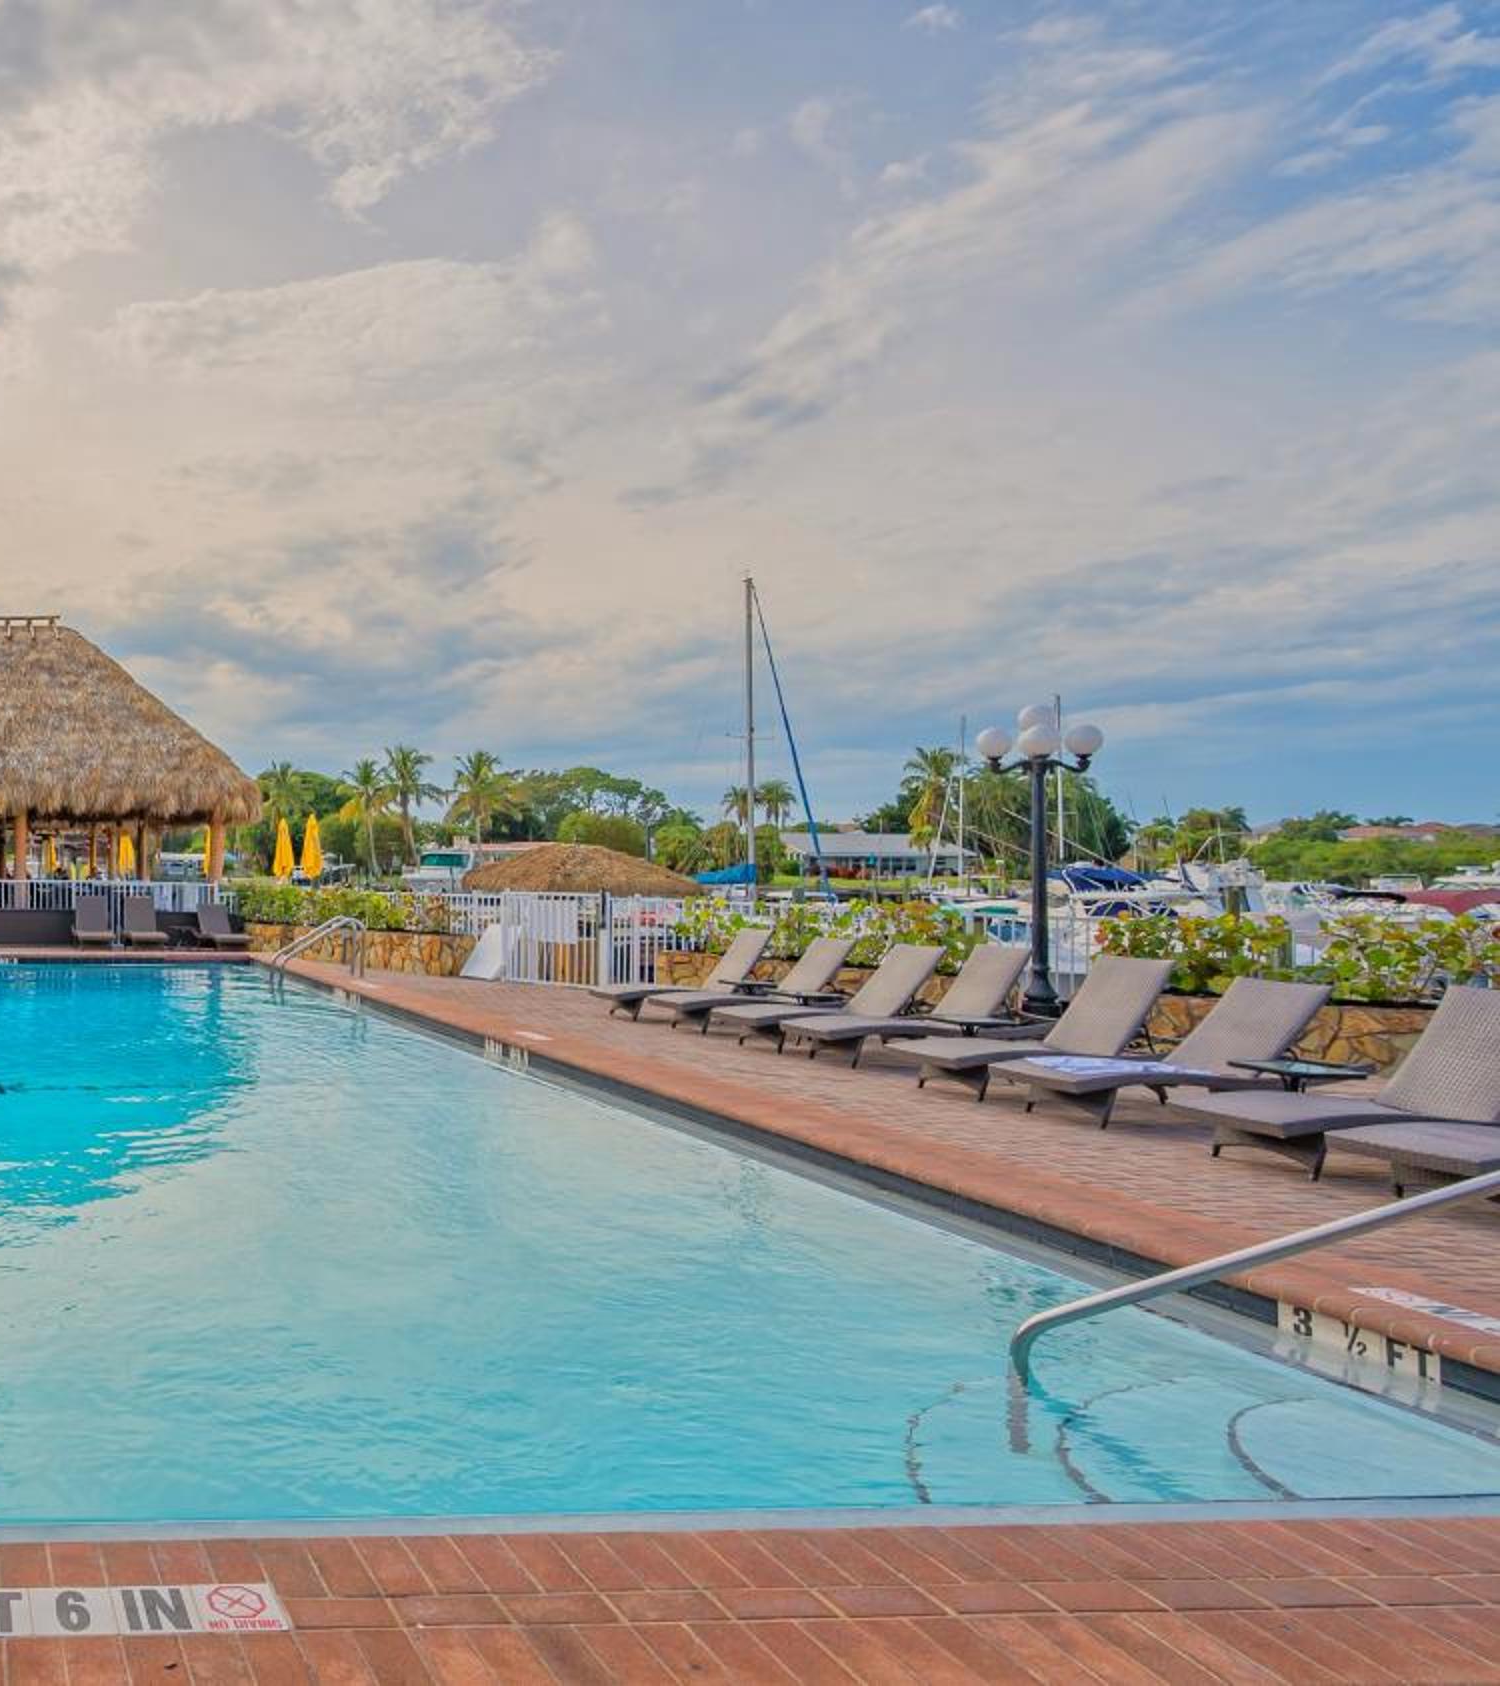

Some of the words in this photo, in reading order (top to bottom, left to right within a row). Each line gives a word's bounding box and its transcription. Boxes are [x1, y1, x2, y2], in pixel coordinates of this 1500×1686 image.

[1293, 1306, 1313, 1338] 3
[56, 1590, 92, 1632] 6
[120, 1587, 194, 1632] IN
[208, 1619, 229, 1629] NO
[233, 1618, 284, 1629] DIVING
